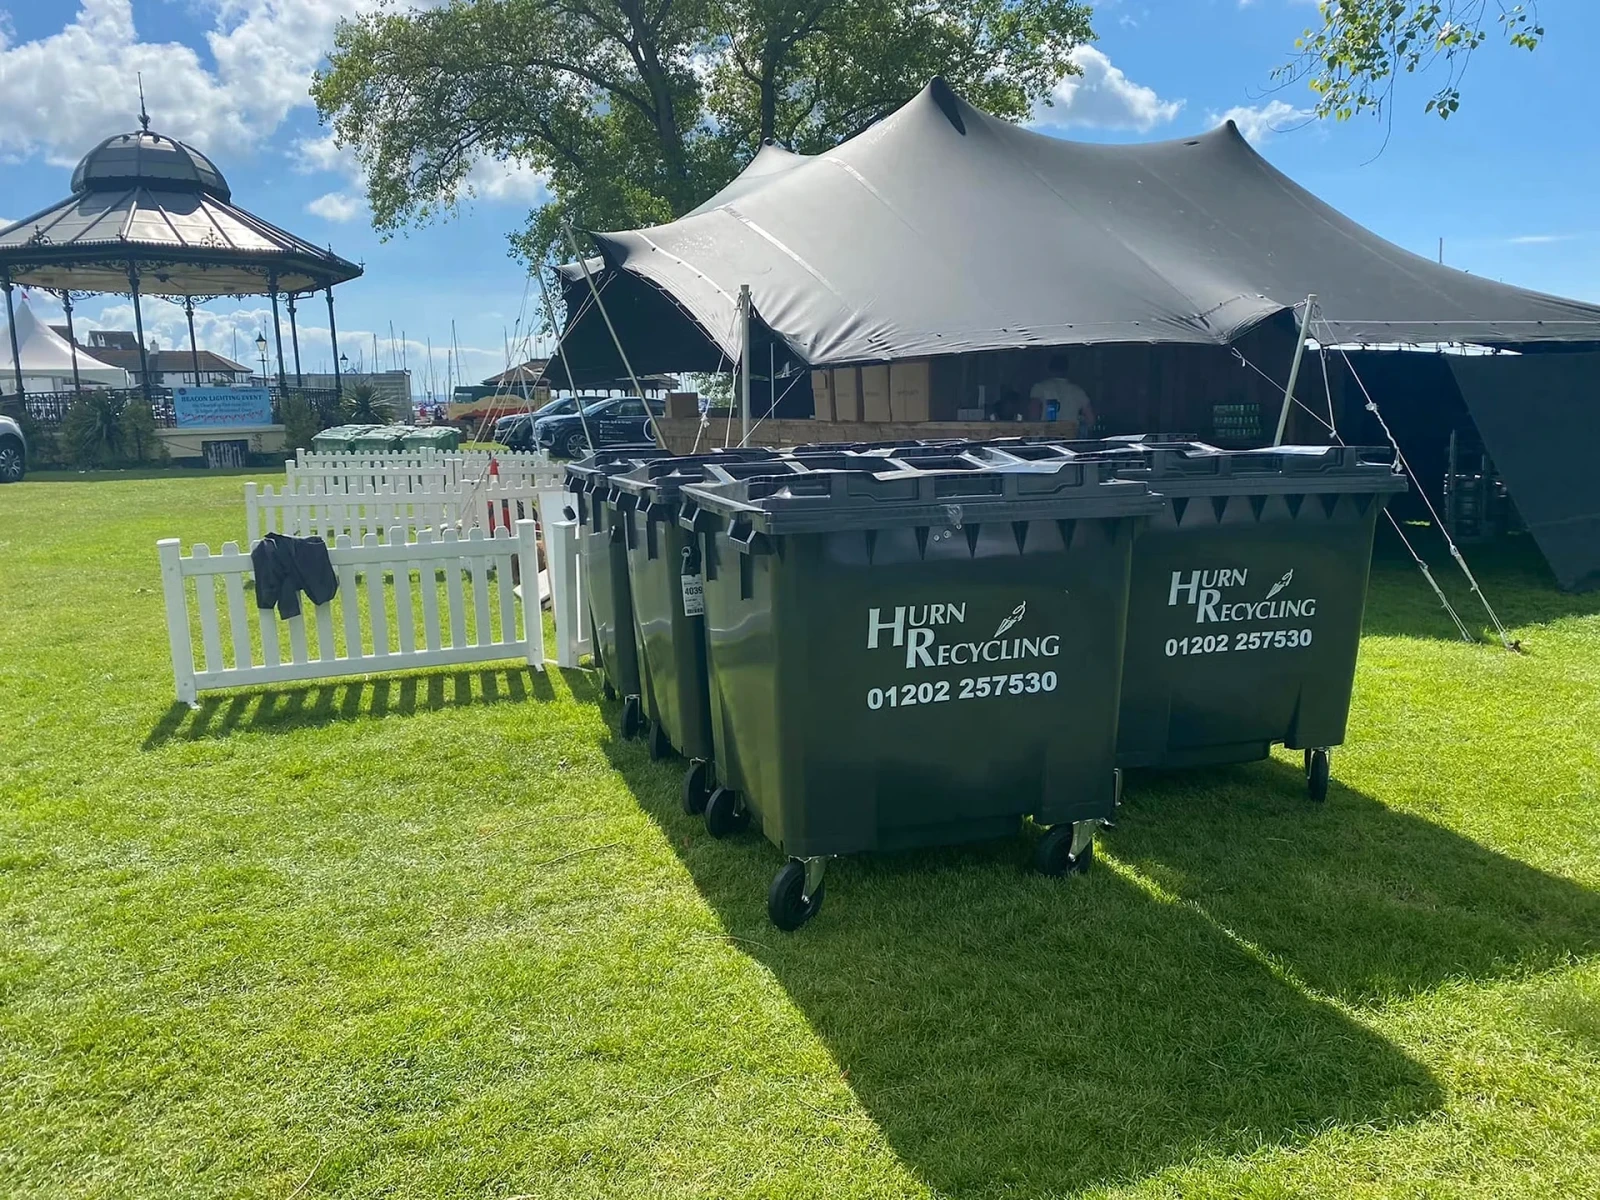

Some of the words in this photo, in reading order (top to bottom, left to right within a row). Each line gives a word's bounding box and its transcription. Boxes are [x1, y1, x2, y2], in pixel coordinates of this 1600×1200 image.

[1168, 568, 1248, 606] HURN
[1196, 588, 1316, 623] RECYCLING
[867, 602, 966, 649] HURN
[1165, 634, 1229, 657] 01202
[1234, 628, 1313, 651] 257530
[905, 627, 1061, 669] RECYCLING
[866, 680, 950, 710] 01202
[958, 671, 1058, 699] 257530
